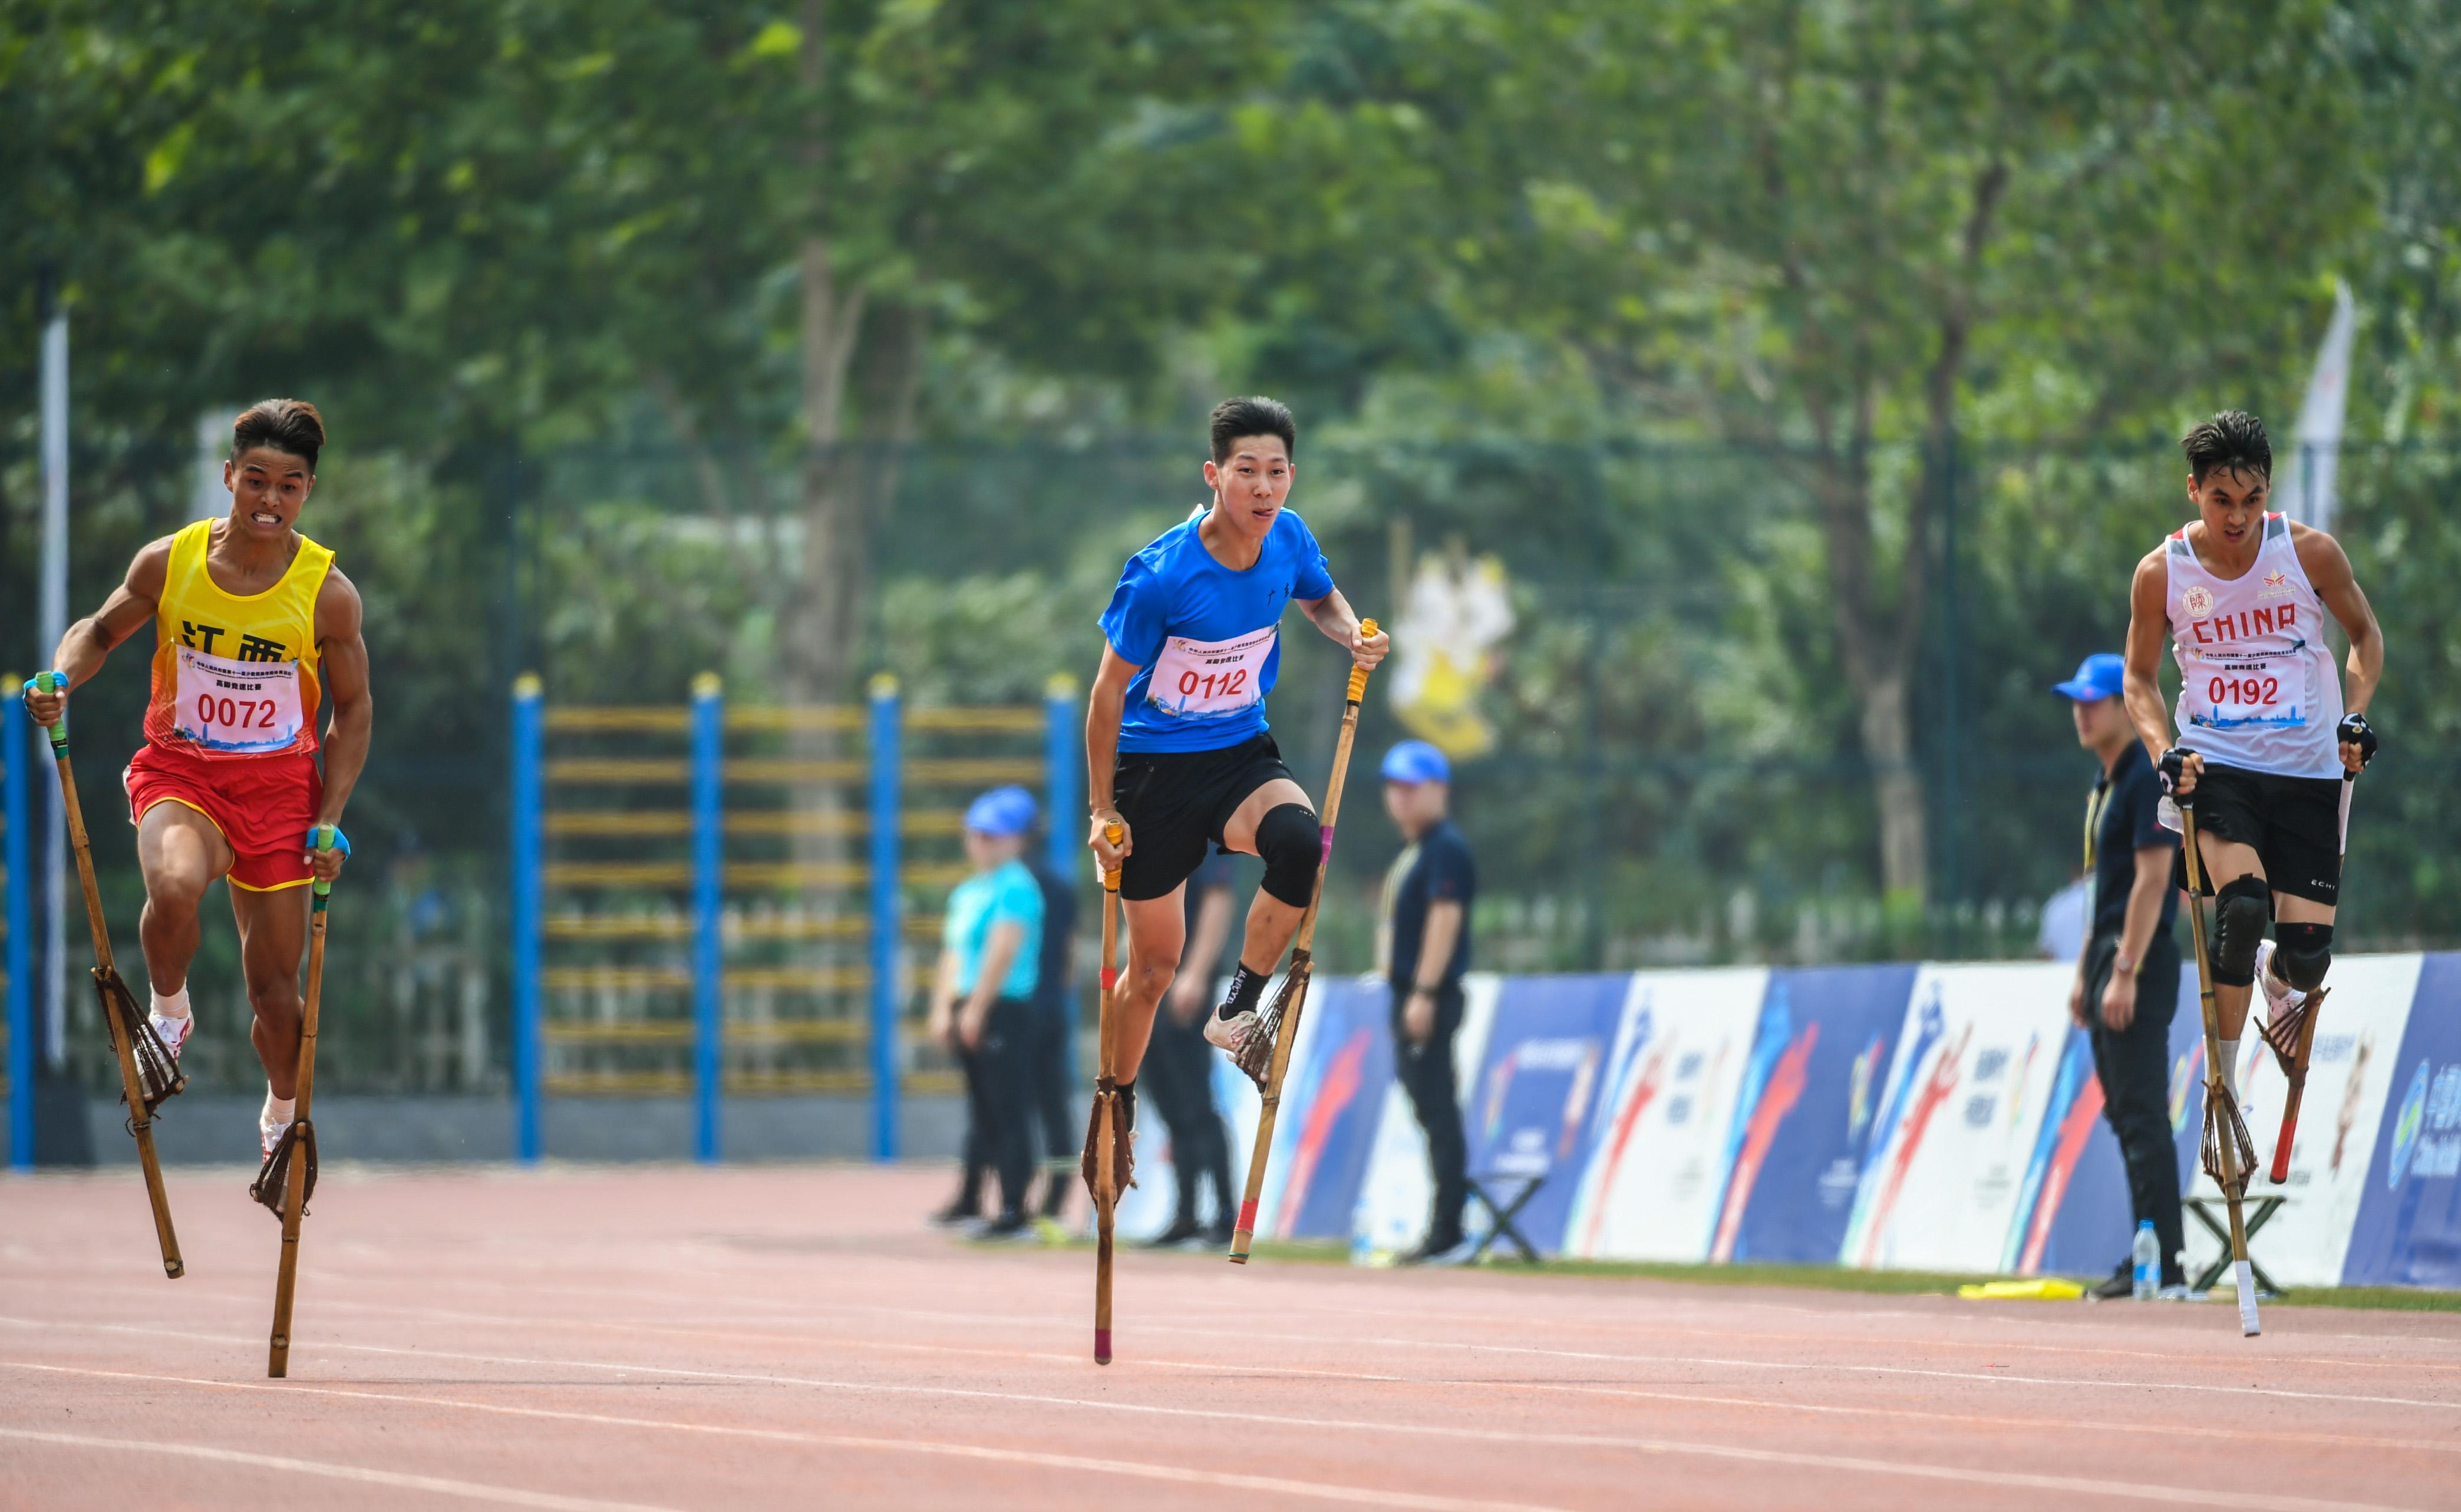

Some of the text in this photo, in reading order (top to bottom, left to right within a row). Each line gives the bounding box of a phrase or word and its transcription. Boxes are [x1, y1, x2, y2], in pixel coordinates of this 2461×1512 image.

[2192, 603, 2295, 644] CHINA
[182, 620, 286, 662] 江西
[216, 679, 262, 691] 高脚竞速比赛
[1179, 669, 1246, 699] 0112
[2209, 677, 2278, 705] 0192
[198, 694, 276, 728] 0072
